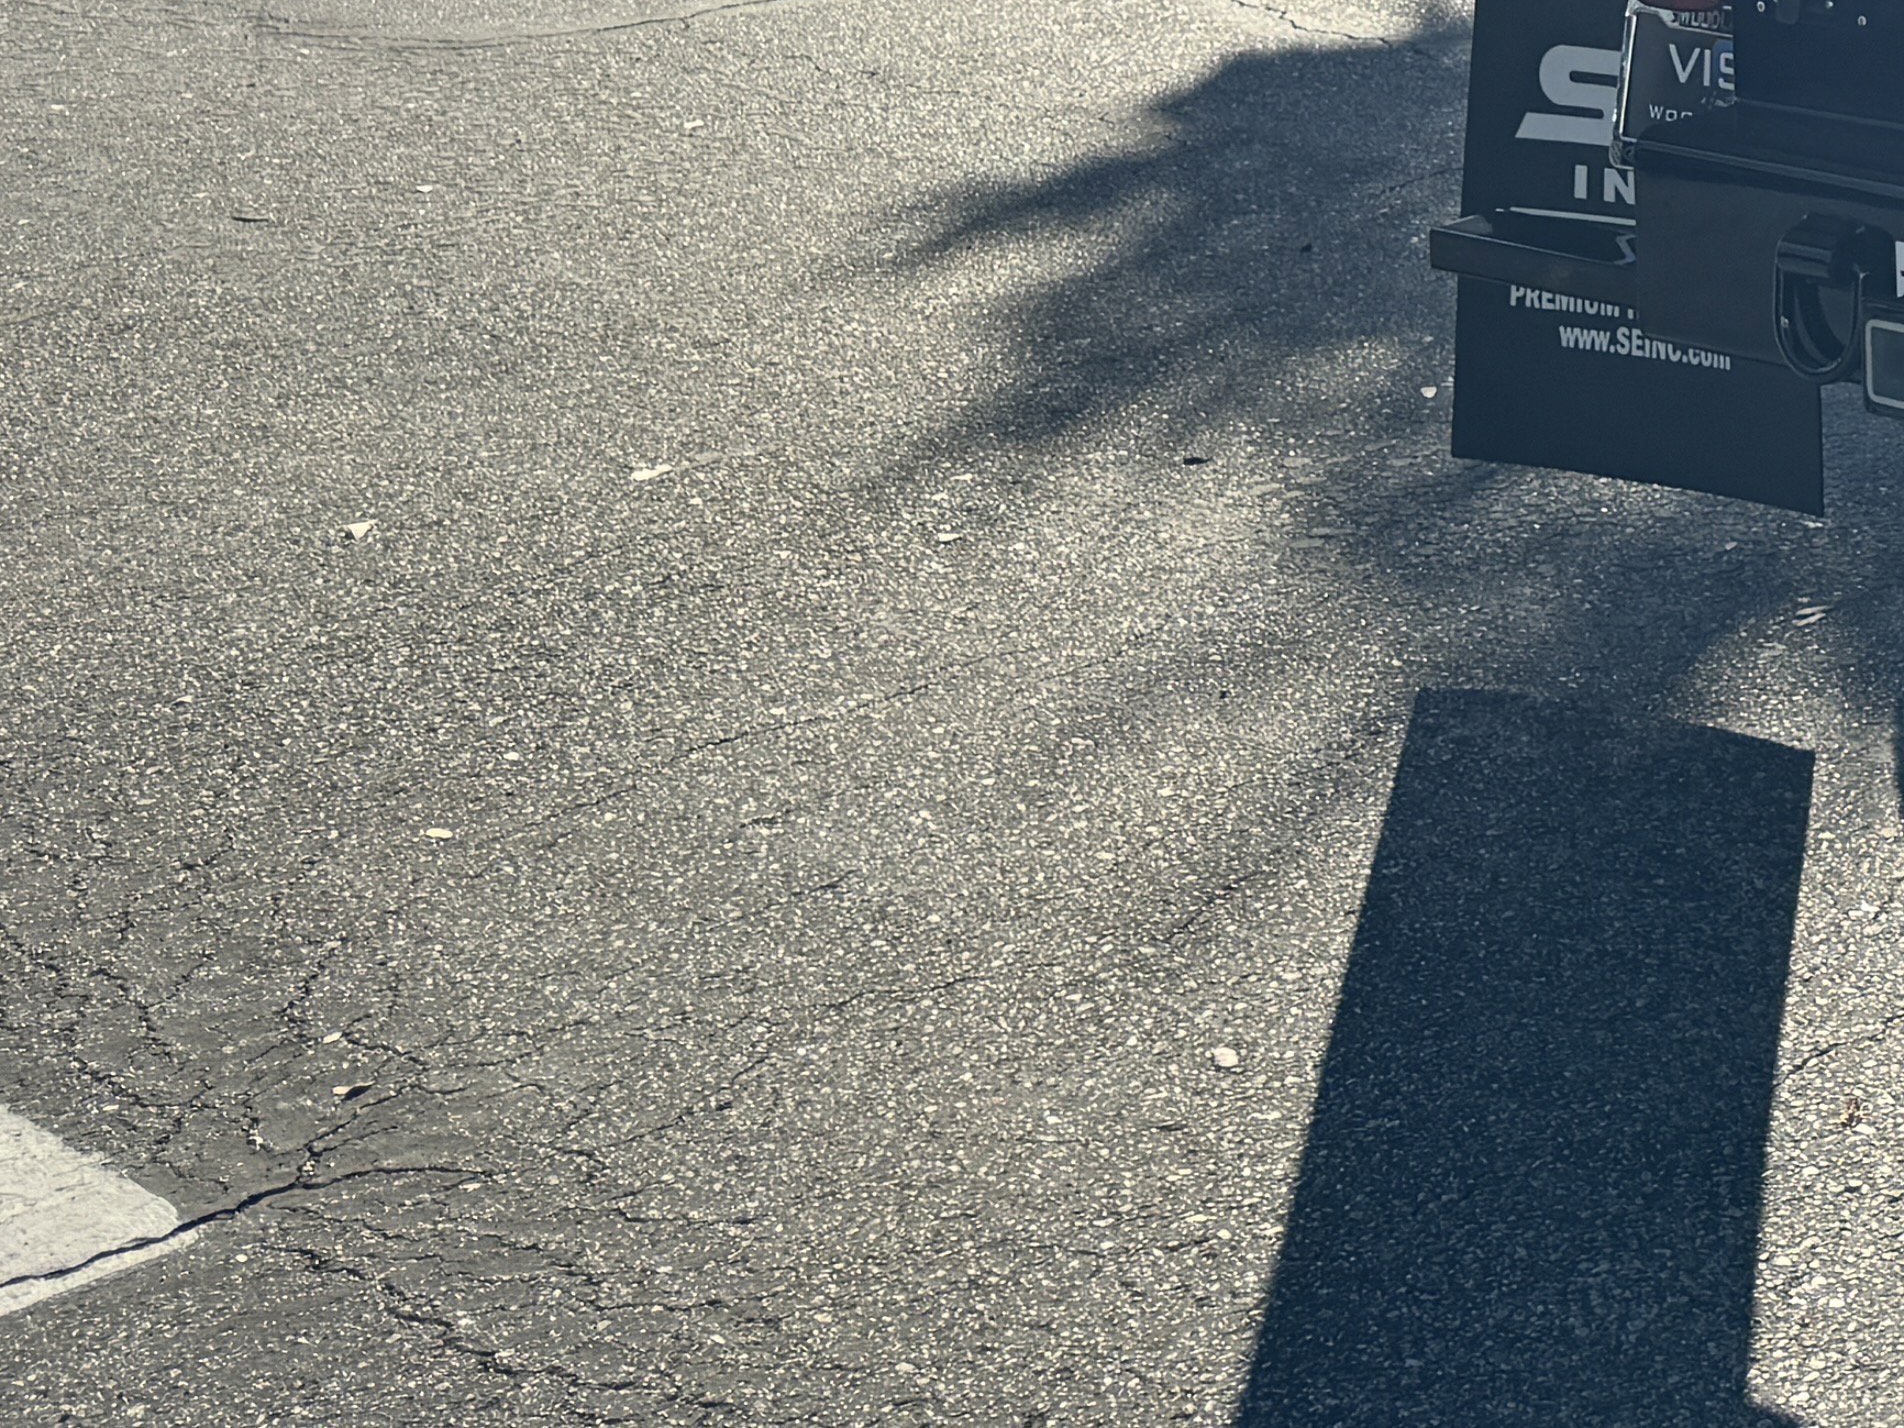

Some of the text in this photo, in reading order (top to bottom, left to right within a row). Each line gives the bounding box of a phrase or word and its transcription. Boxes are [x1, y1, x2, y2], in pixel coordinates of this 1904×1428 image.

[1669, 43, 1735, 91] VIS
[1514, 44, 1623, 147] S
[1573, 164, 1637, 206] IN
